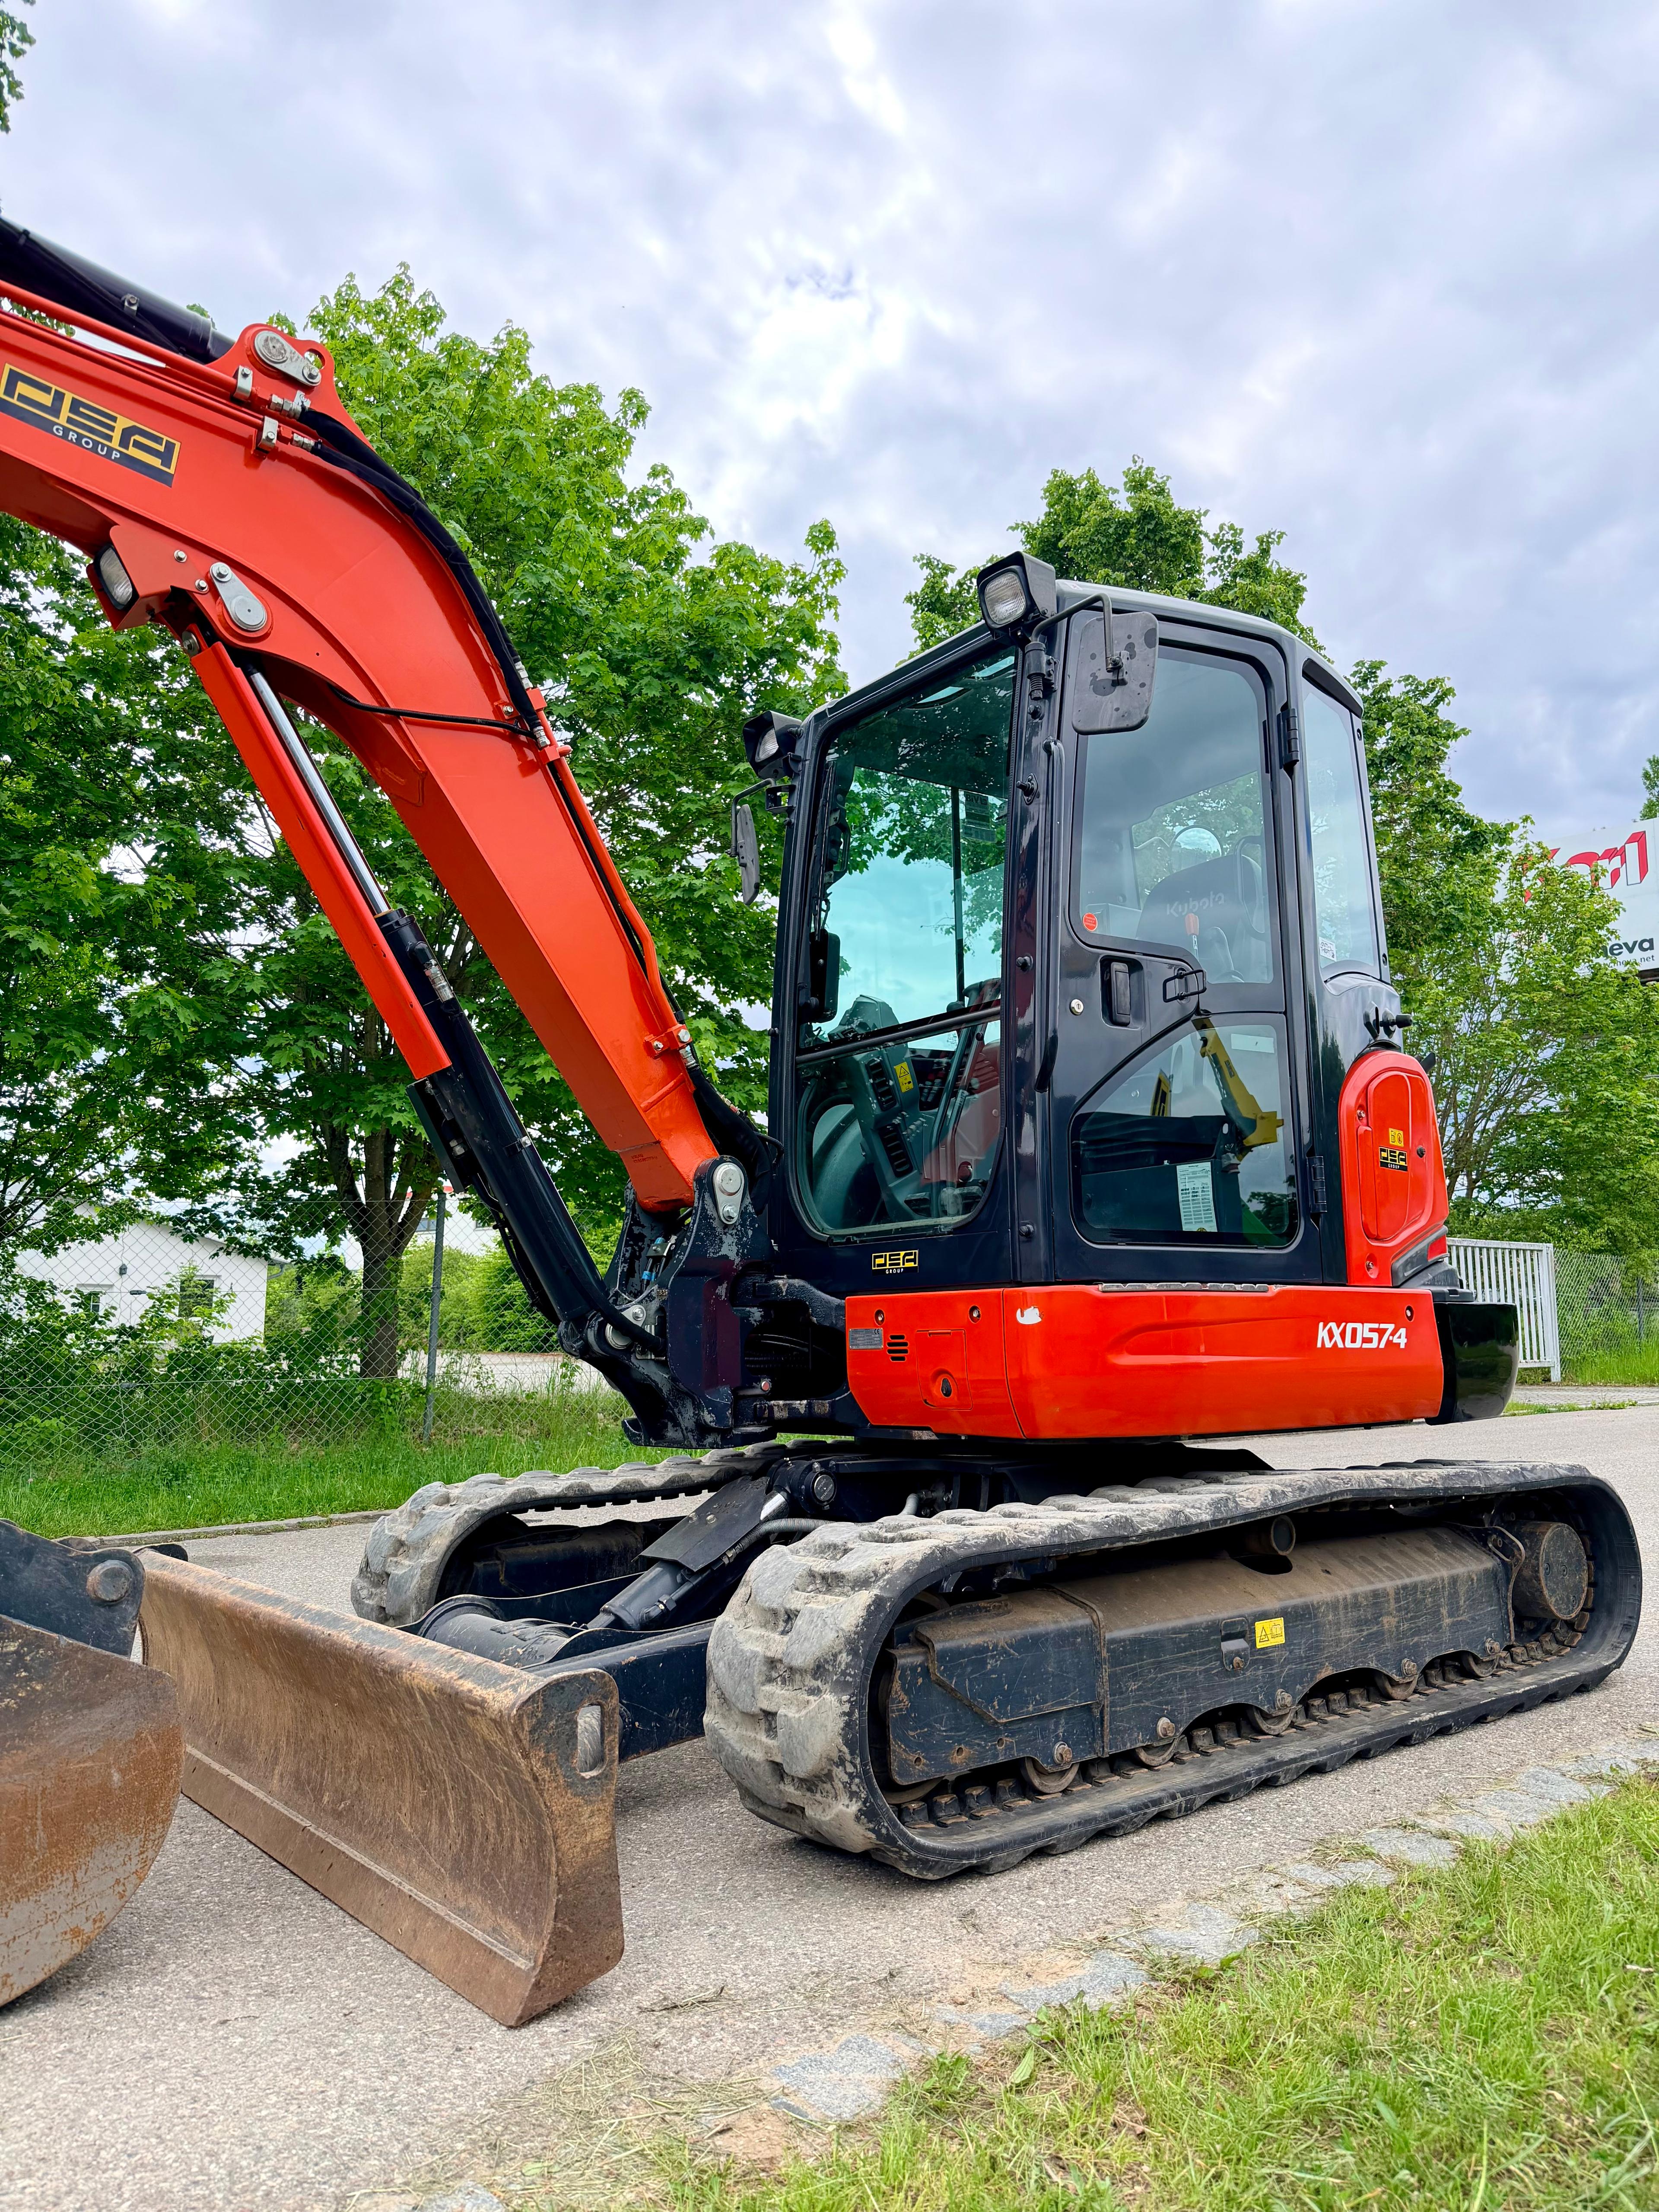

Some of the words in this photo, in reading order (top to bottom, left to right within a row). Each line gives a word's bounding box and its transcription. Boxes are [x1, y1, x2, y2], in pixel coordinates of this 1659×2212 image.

[53, 425, 120, 460] GROUP
[1166, 891, 1225, 917] Kubota
[1317, 1322, 1407, 1348] KX057-4
